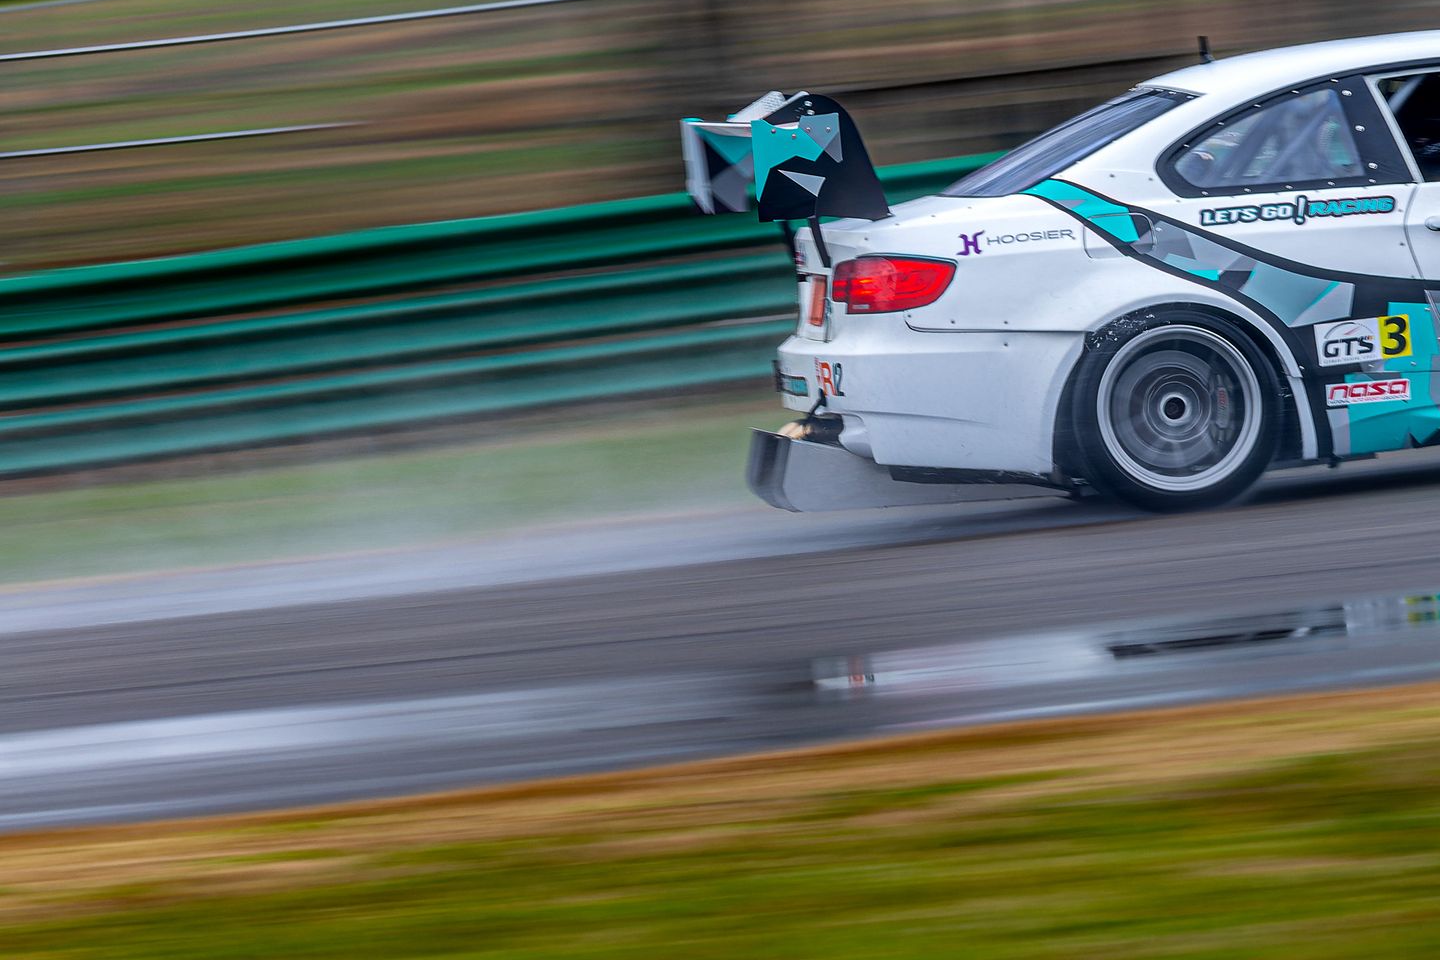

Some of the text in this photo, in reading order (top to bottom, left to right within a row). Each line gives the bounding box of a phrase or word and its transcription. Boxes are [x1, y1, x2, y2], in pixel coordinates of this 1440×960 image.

[1201, 206, 1260, 226] LETS
[1307, 196, 1395, 218] RACING
[986, 229, 1076, 246] HOOSIER
[1323, 316, 1407, 358] GTS 3
[819, 361, 838, 397] R
